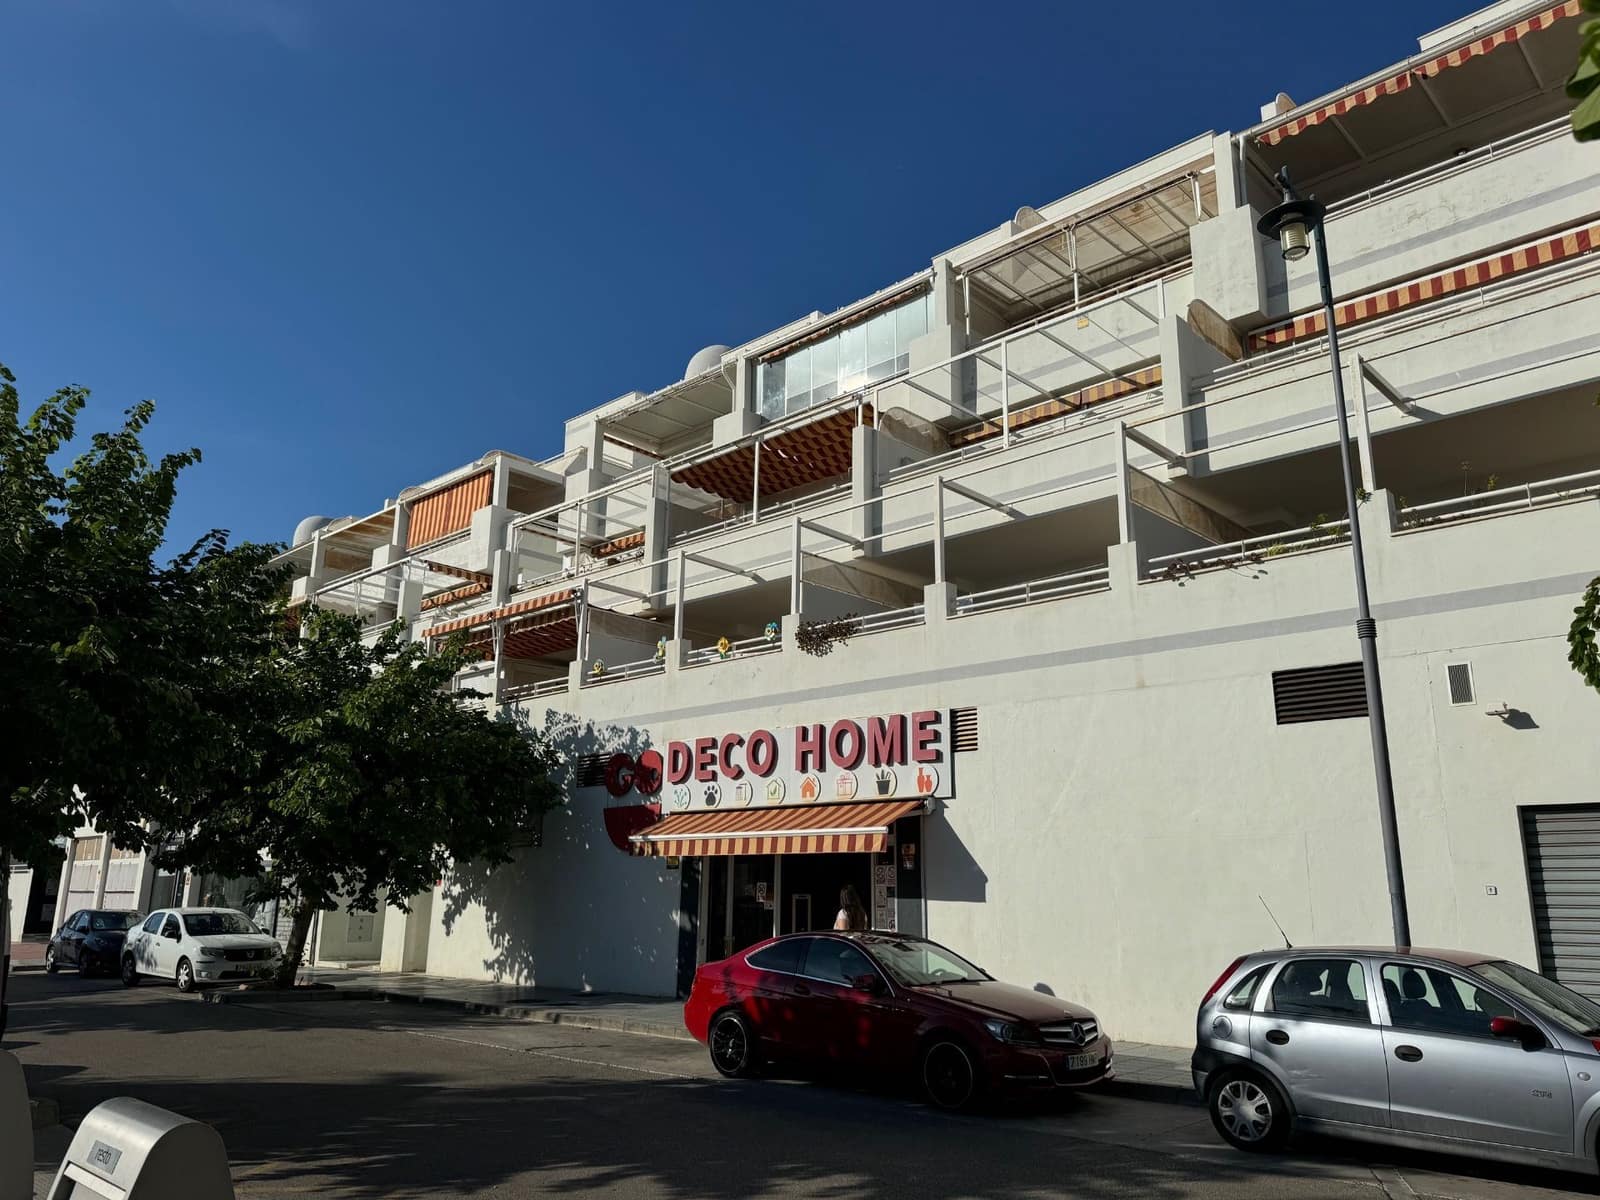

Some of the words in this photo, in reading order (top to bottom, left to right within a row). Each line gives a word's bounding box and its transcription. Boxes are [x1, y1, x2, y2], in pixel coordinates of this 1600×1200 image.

[605, 750, 664, 797] GO
[667, 729, 778, 784] DECO
[795, 710, 943, 774] HOME
